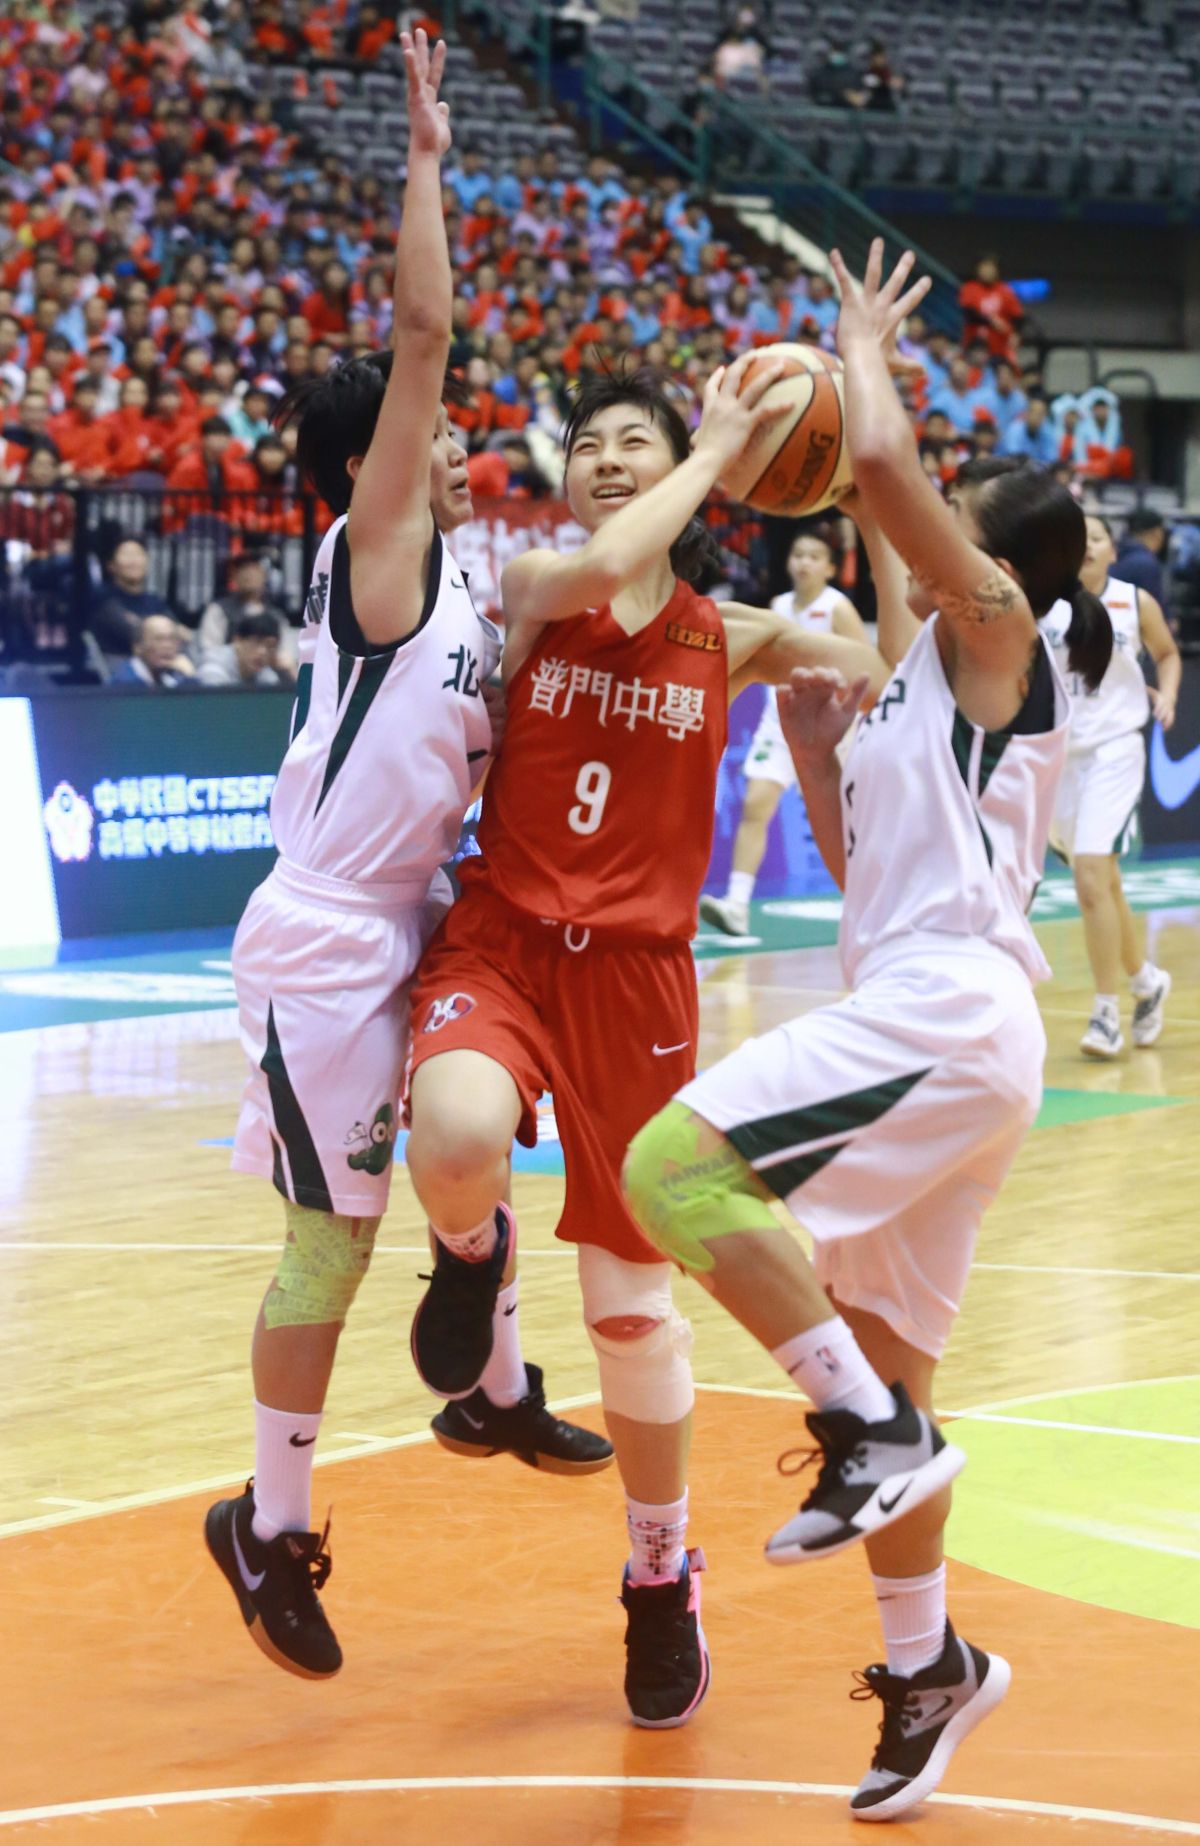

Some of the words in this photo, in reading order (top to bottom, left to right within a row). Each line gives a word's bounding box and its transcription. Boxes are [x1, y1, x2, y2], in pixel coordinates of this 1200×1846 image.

[528, 656, 706, 742] 普門中學
[567, 760, 612, 835] 9
